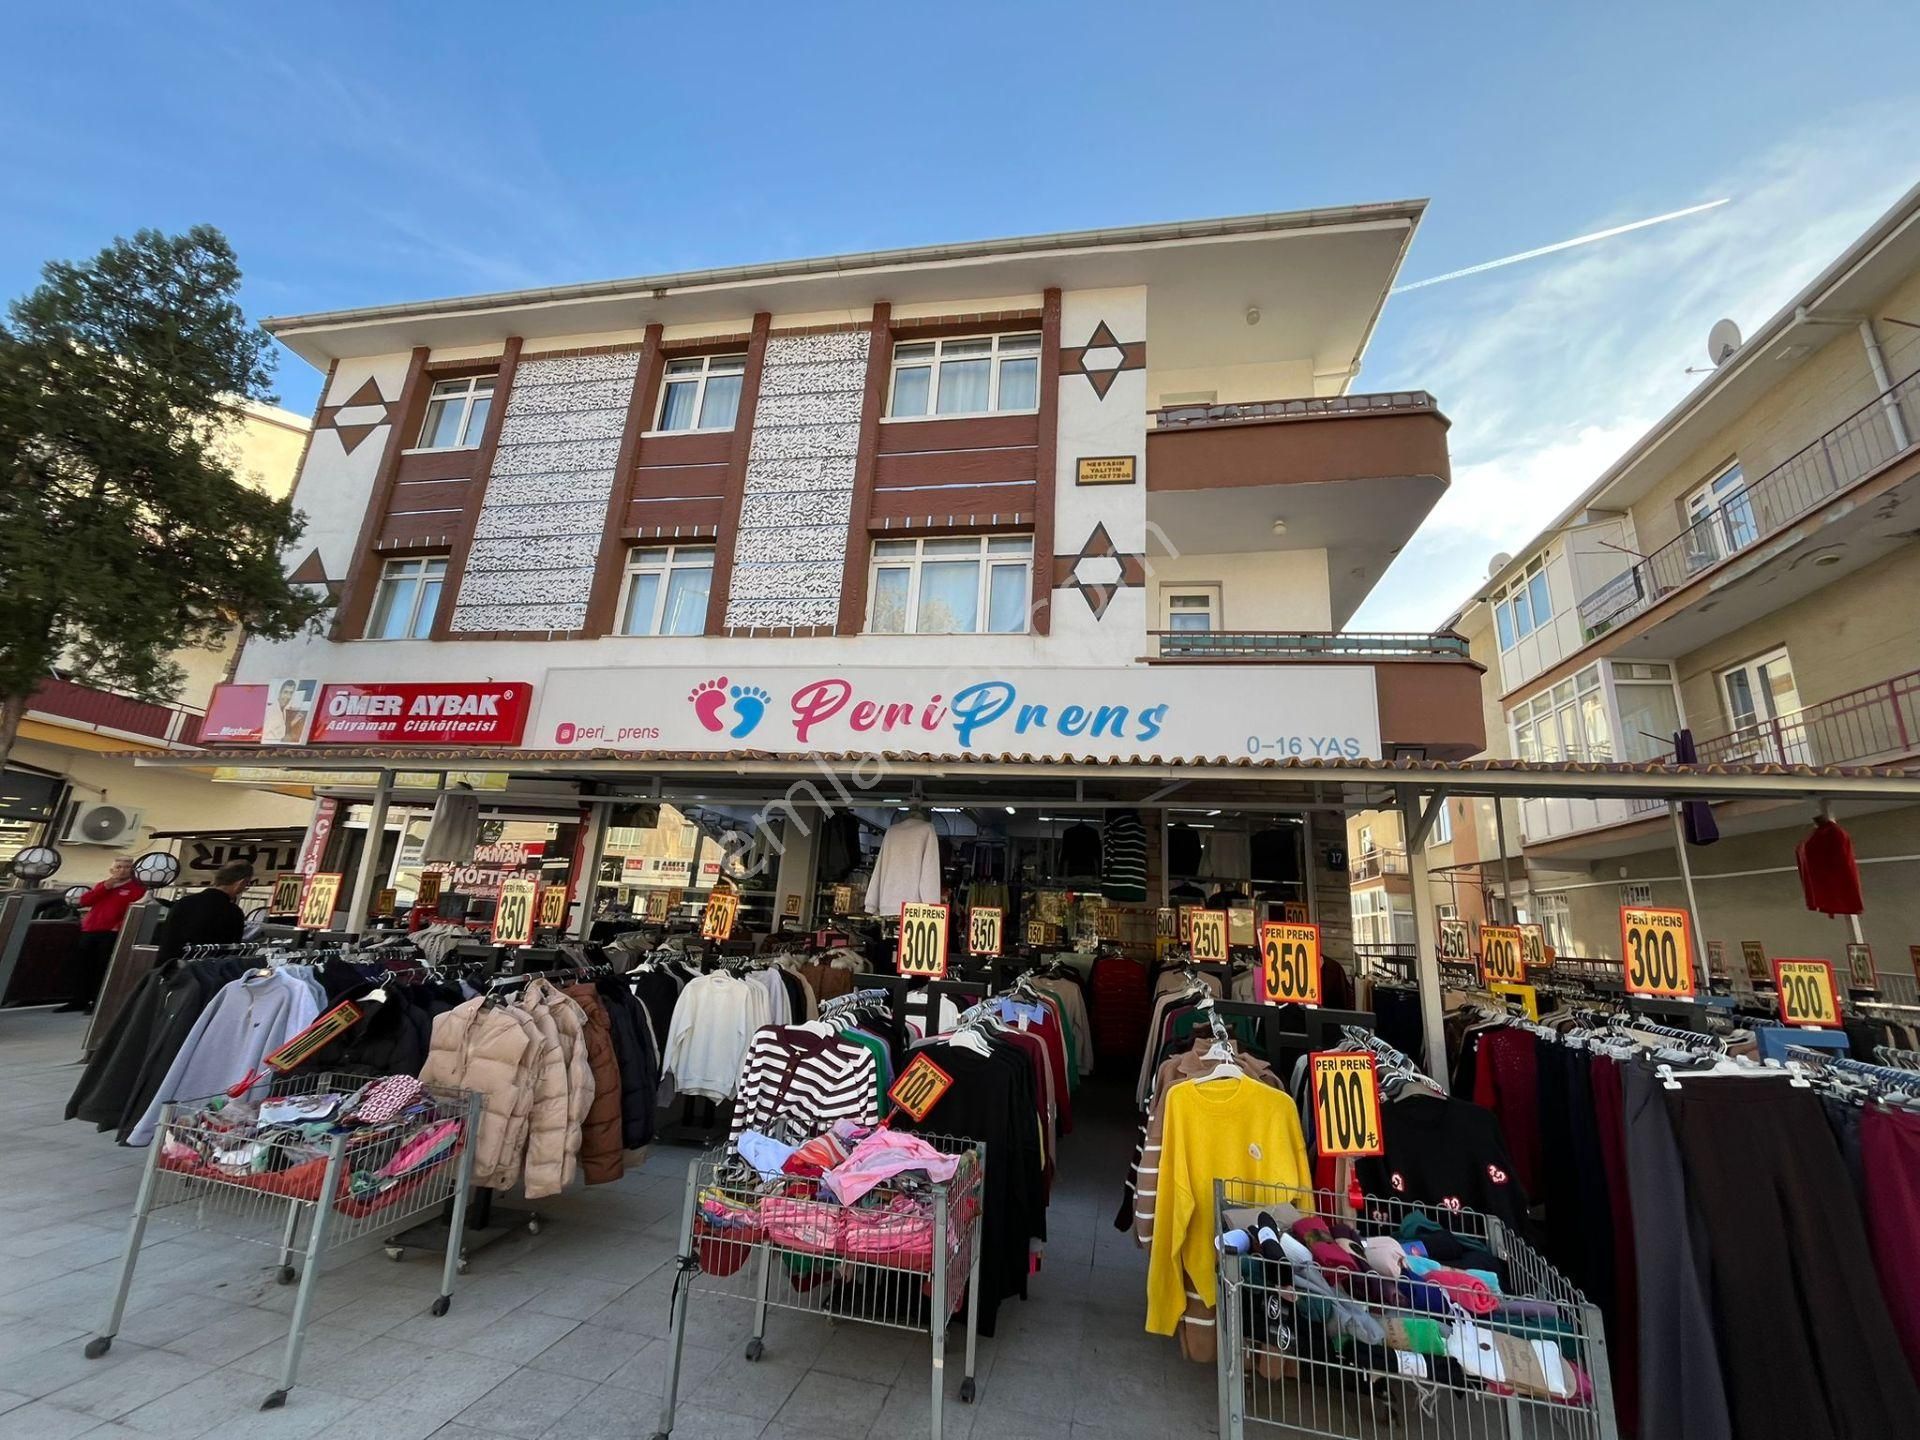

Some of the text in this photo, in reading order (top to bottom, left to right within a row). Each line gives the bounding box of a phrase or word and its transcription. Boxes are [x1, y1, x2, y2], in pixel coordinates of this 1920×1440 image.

[328, 691, 403, 716] ÖMER
[791, 678, 1169, 747] Peri Prens
[325, 720, 496, 732] Adıyaman Çiğköftecisi
[617, 727, 659, 742] prens
[1308, 737, 1360, 760] YAŞ
[1332, 853, 1342, 864] 17
[905, 907, 945, 920] PERİ PRENS
[1651, 916, 1683, 928] PRENS
[1264, 926, 1315, 941] PERİ PRENS
[1798, 964, 1824, 973] PRENS
[1315, 1057, 1371, 1071] PERİ PRENS
